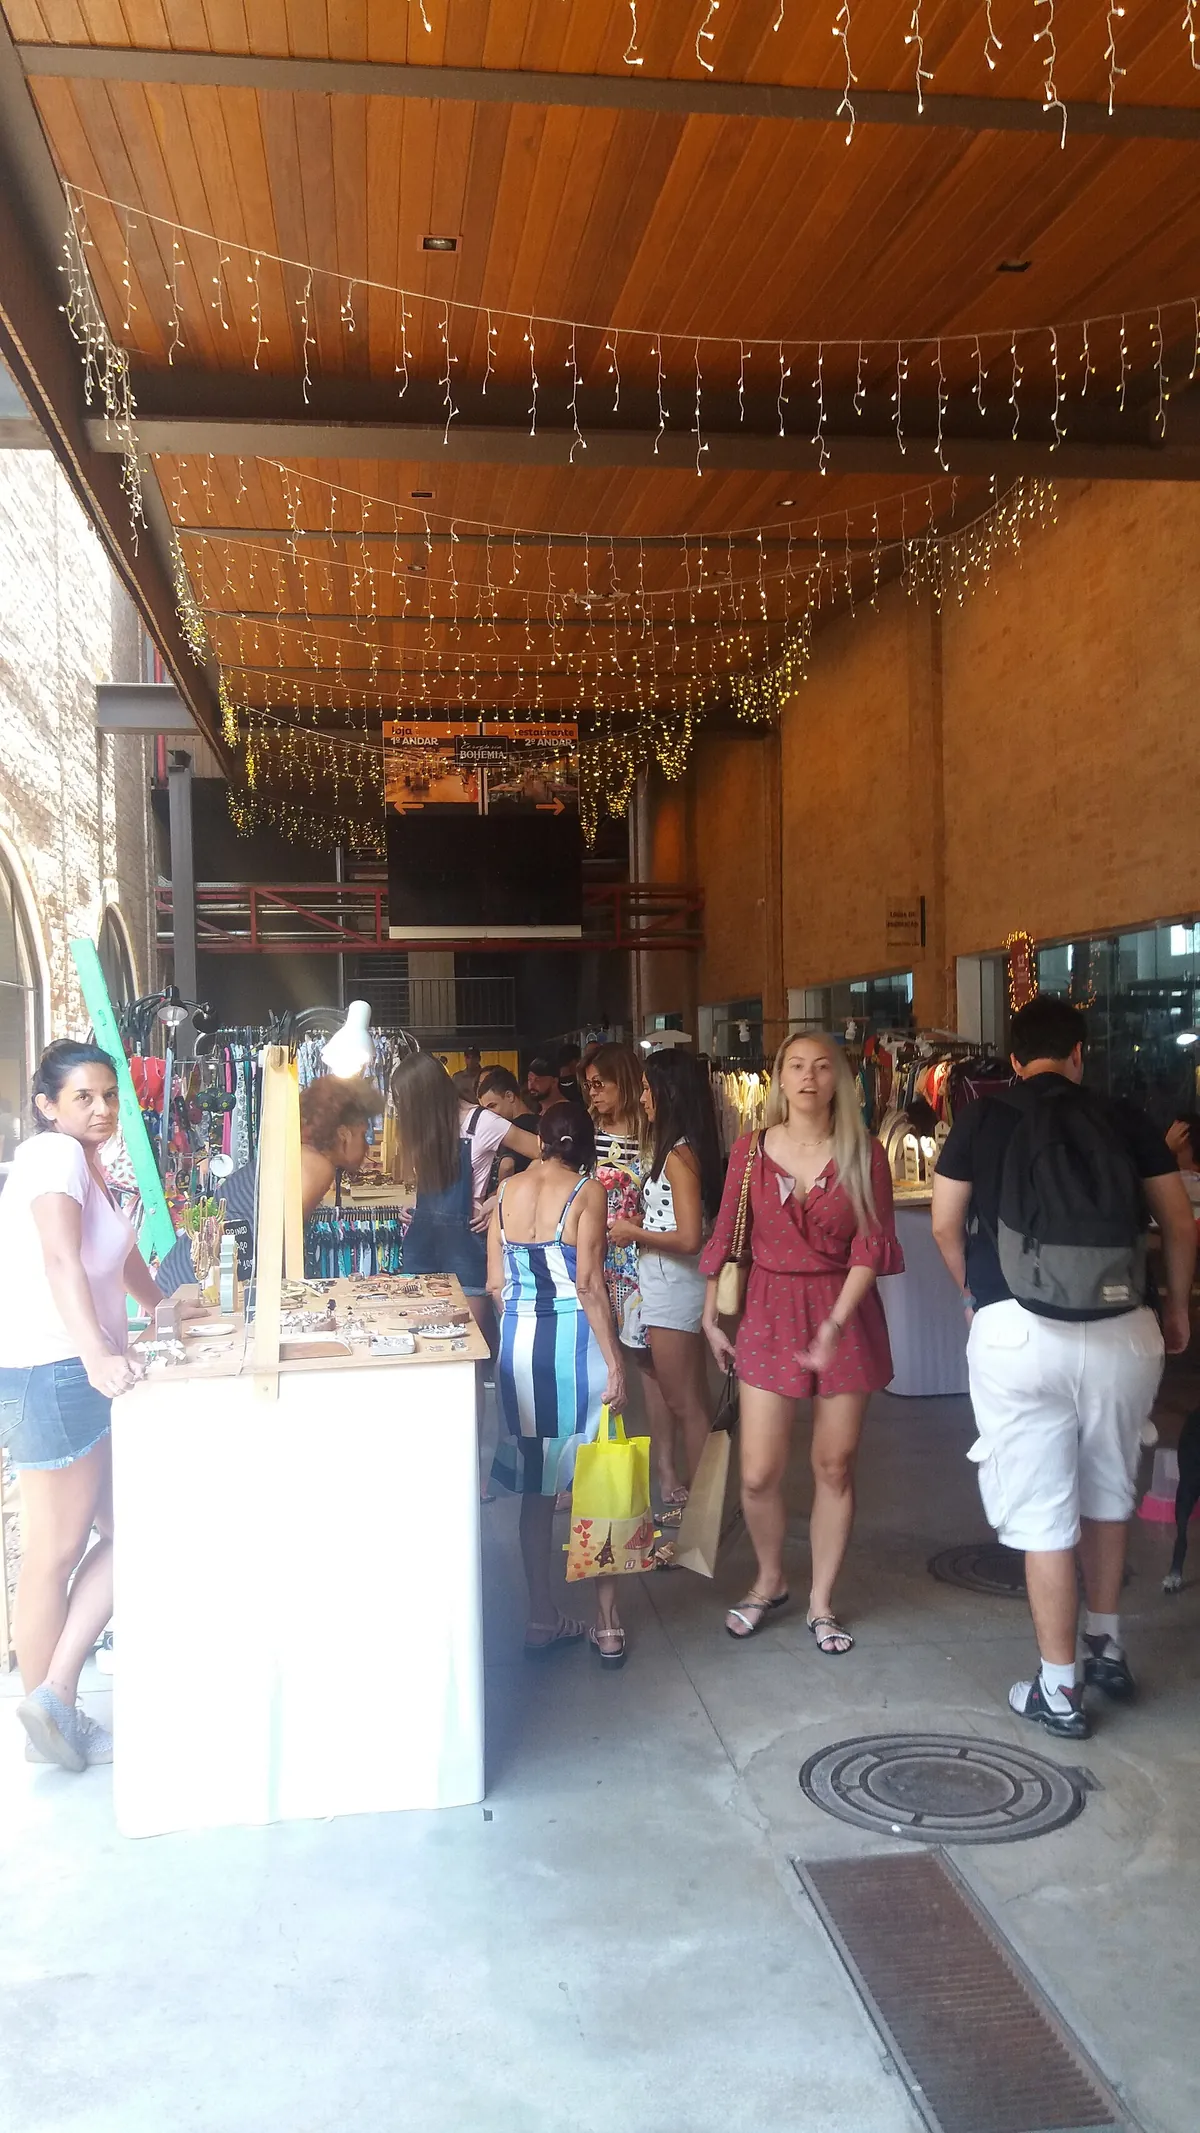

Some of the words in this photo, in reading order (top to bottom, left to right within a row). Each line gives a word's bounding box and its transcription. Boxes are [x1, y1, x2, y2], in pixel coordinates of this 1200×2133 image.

[391, 725, 413, 737] loja
[514, 728, 575, 737] restaurante
[402, 736, 439, 745] ANDAR
[536, 738, 573, 747] ANDAR
[460, 750, 505, 759] BOHEMIA
